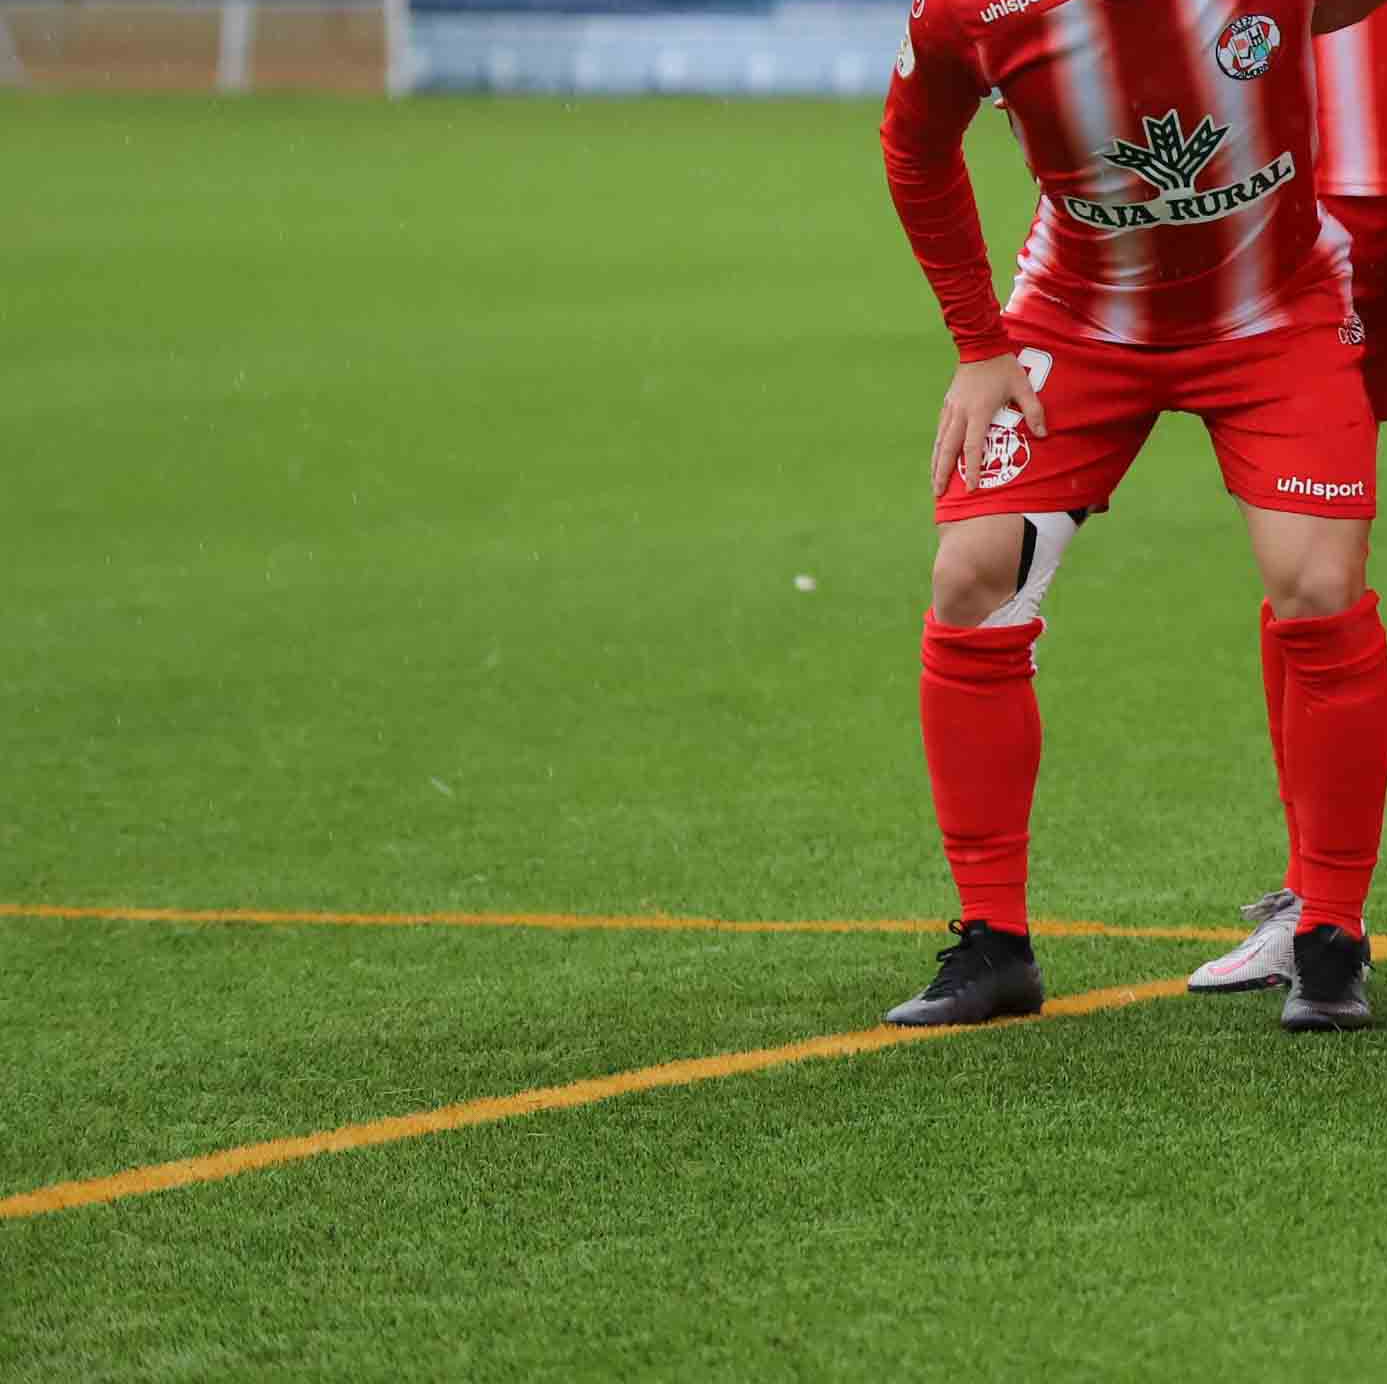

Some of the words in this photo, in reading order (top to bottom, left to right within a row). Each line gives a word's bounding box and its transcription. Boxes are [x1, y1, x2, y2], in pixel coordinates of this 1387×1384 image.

[1066, 194, 1160, 229] CAJA
[1168, 158, 1295, 222] RURAL
[1276, 476, 1365, 498] uhlsport
